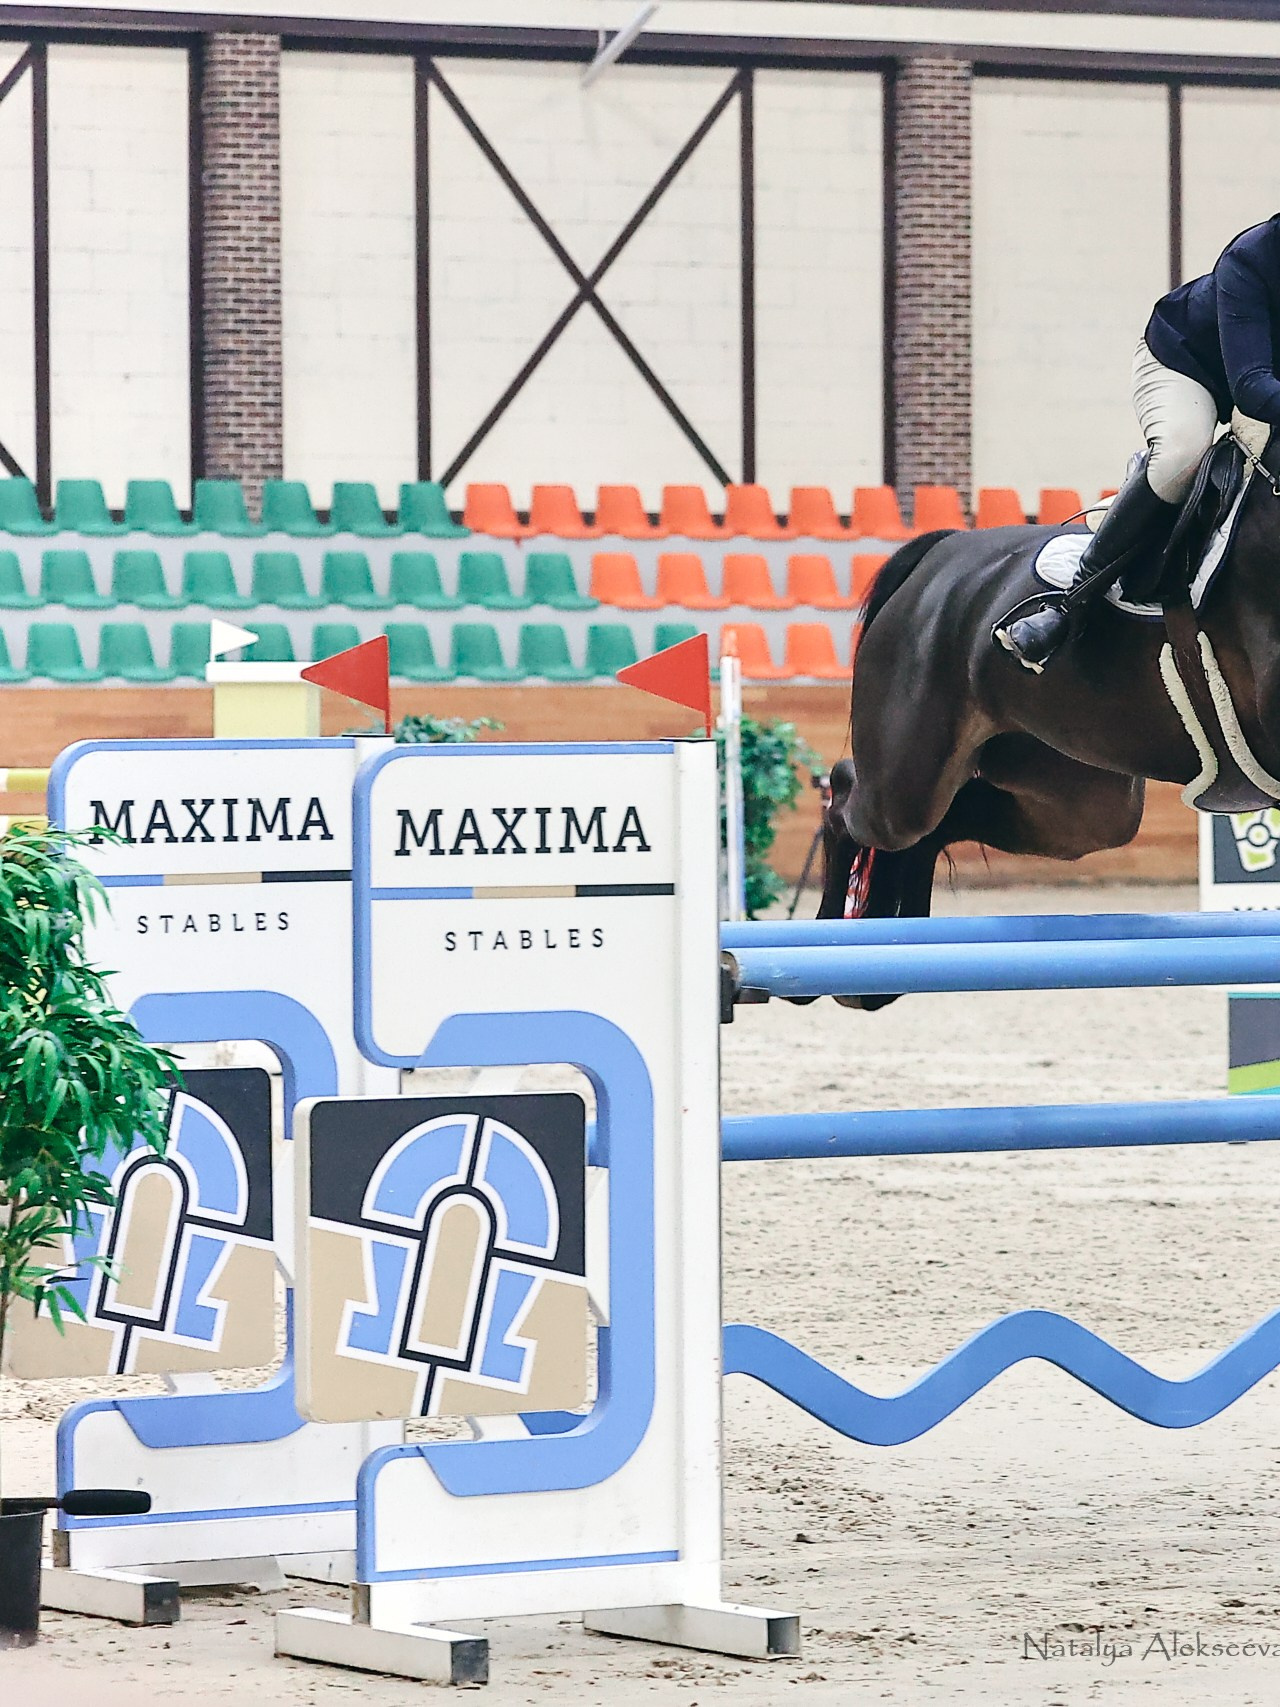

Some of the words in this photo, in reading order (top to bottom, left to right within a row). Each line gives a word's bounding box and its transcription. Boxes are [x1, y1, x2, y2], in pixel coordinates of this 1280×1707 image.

[88, 797, 334, 845] MAXIMA
[394, 806, 652, 857] MAXIMA
[137, 911, 290, 935] STABLES
[445, 927, 605, 952] STABLES
